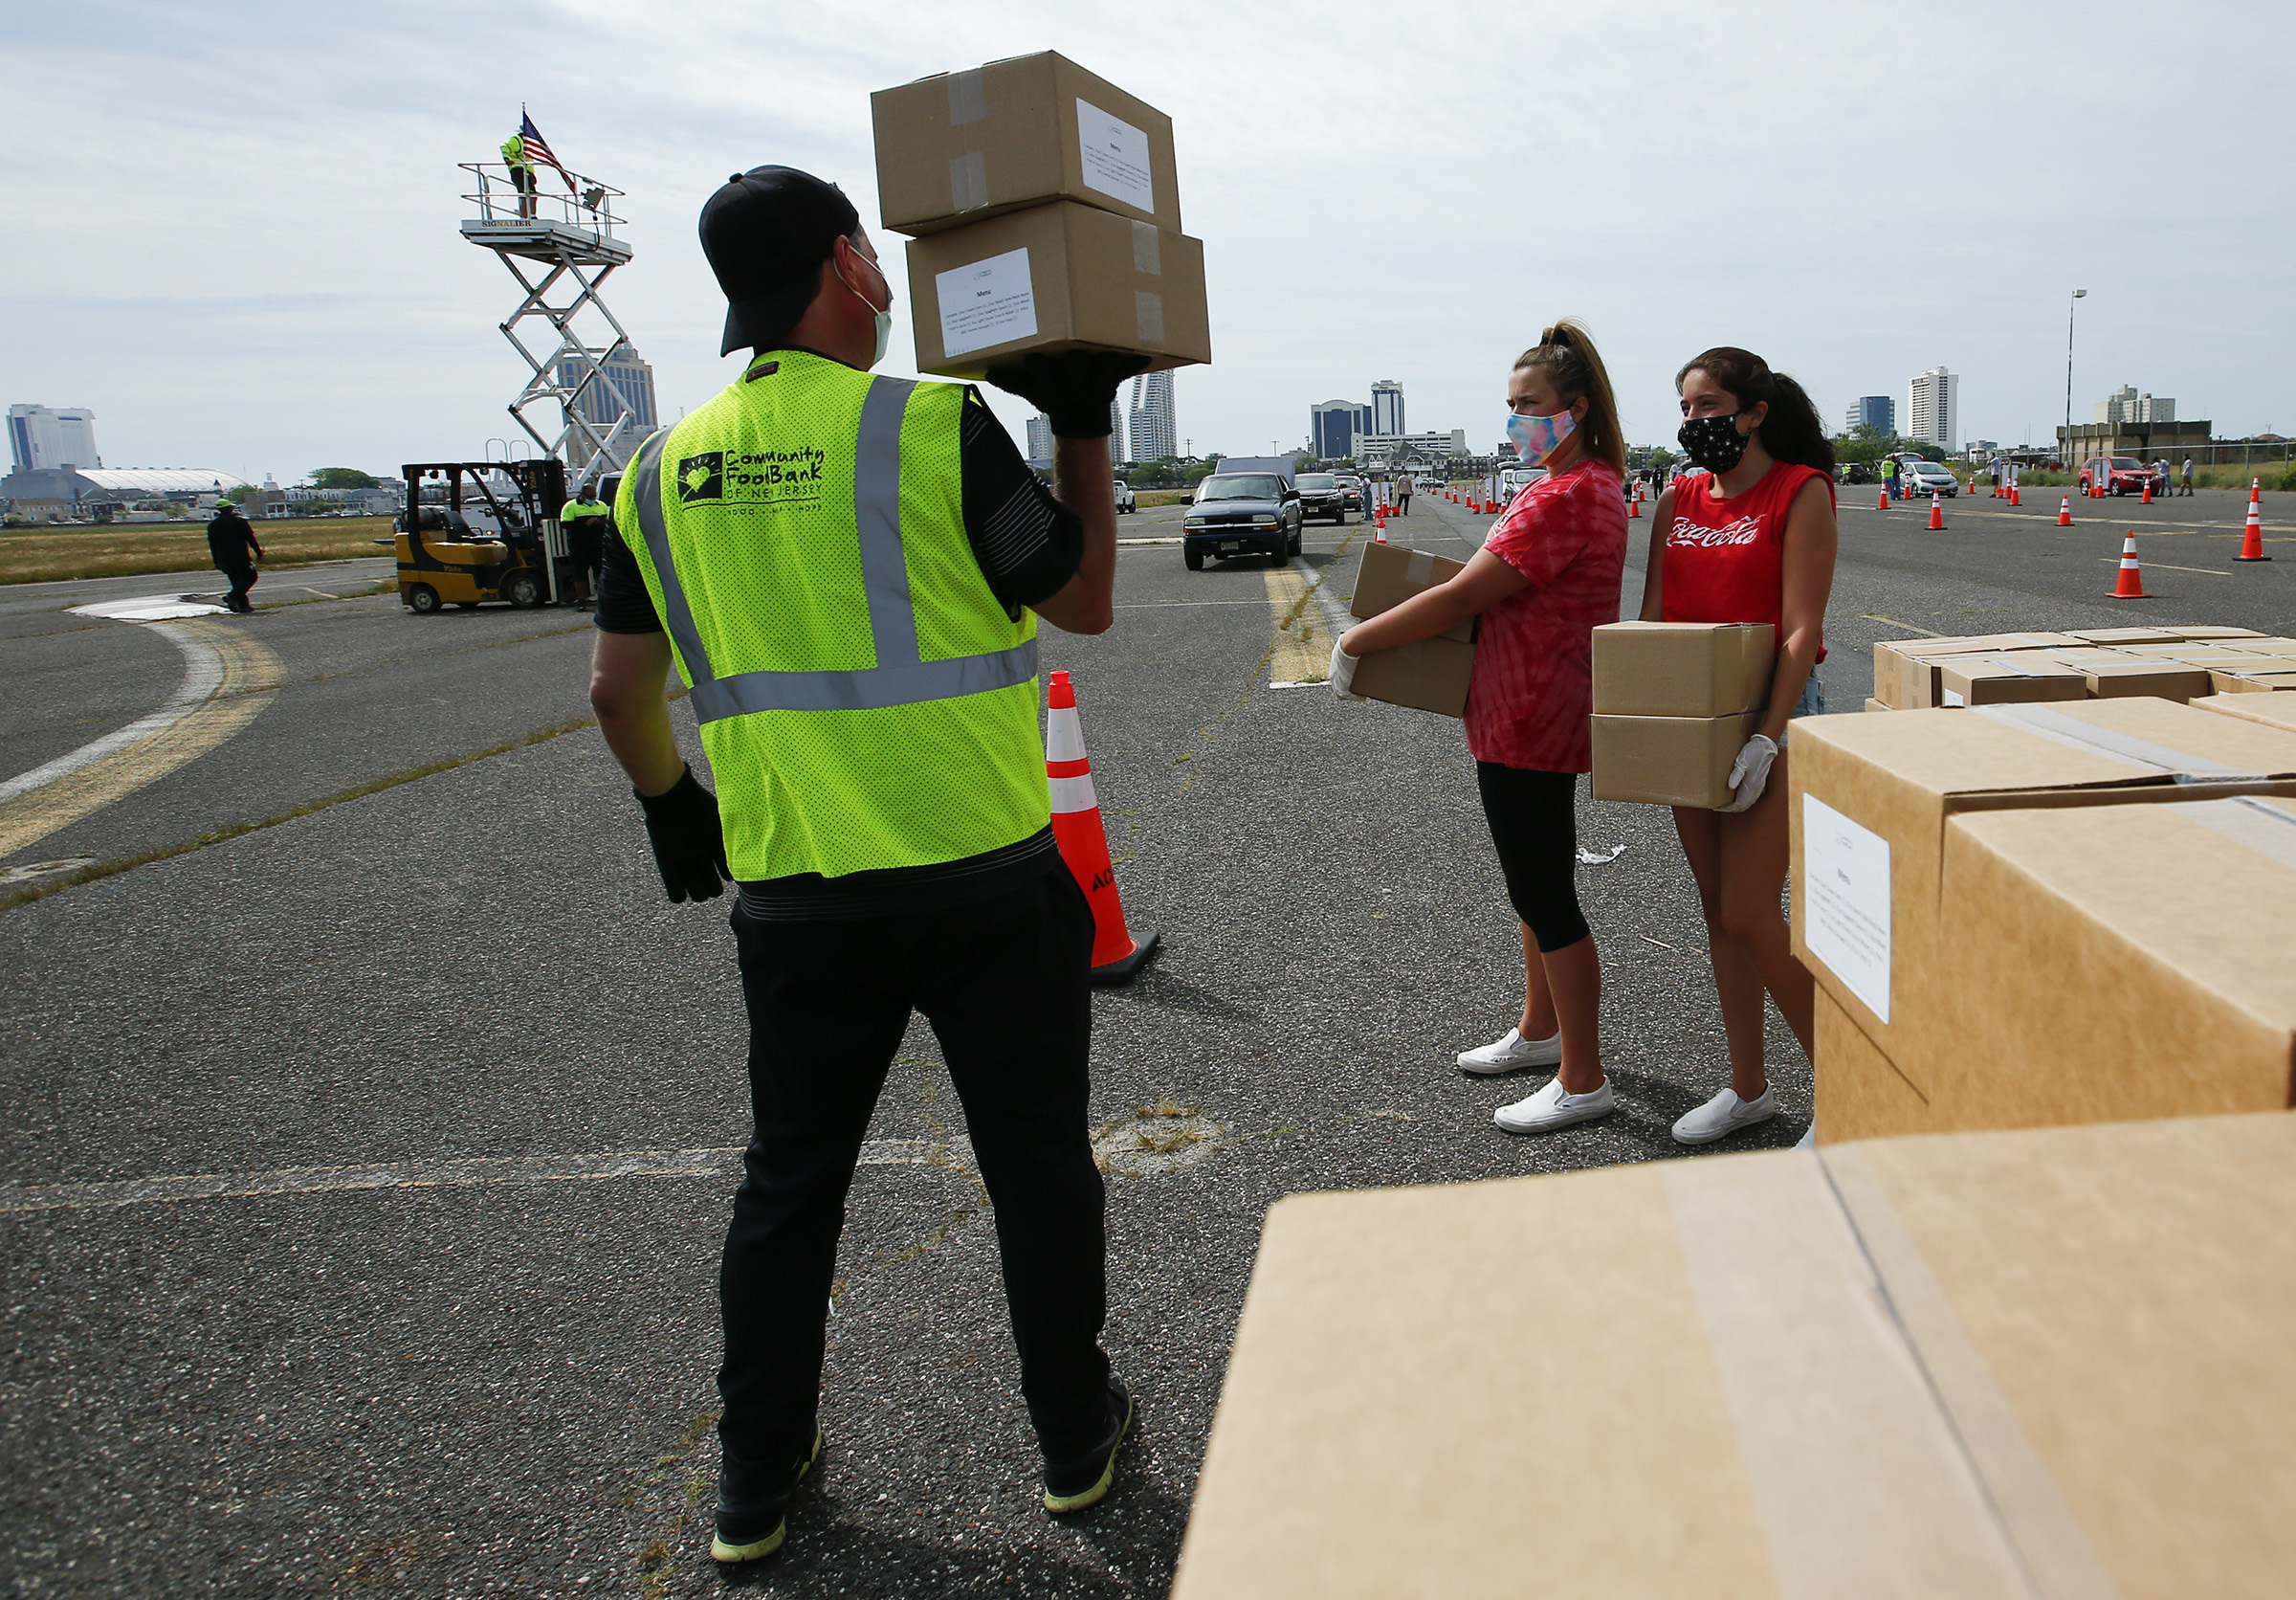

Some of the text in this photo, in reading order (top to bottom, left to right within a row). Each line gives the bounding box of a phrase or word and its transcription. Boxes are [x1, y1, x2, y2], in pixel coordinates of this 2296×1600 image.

[976, 289, 992, 298] Menu
[725, 446, 825, 466] Community
[727, 484, 823, 500] OF NE JERSEY
